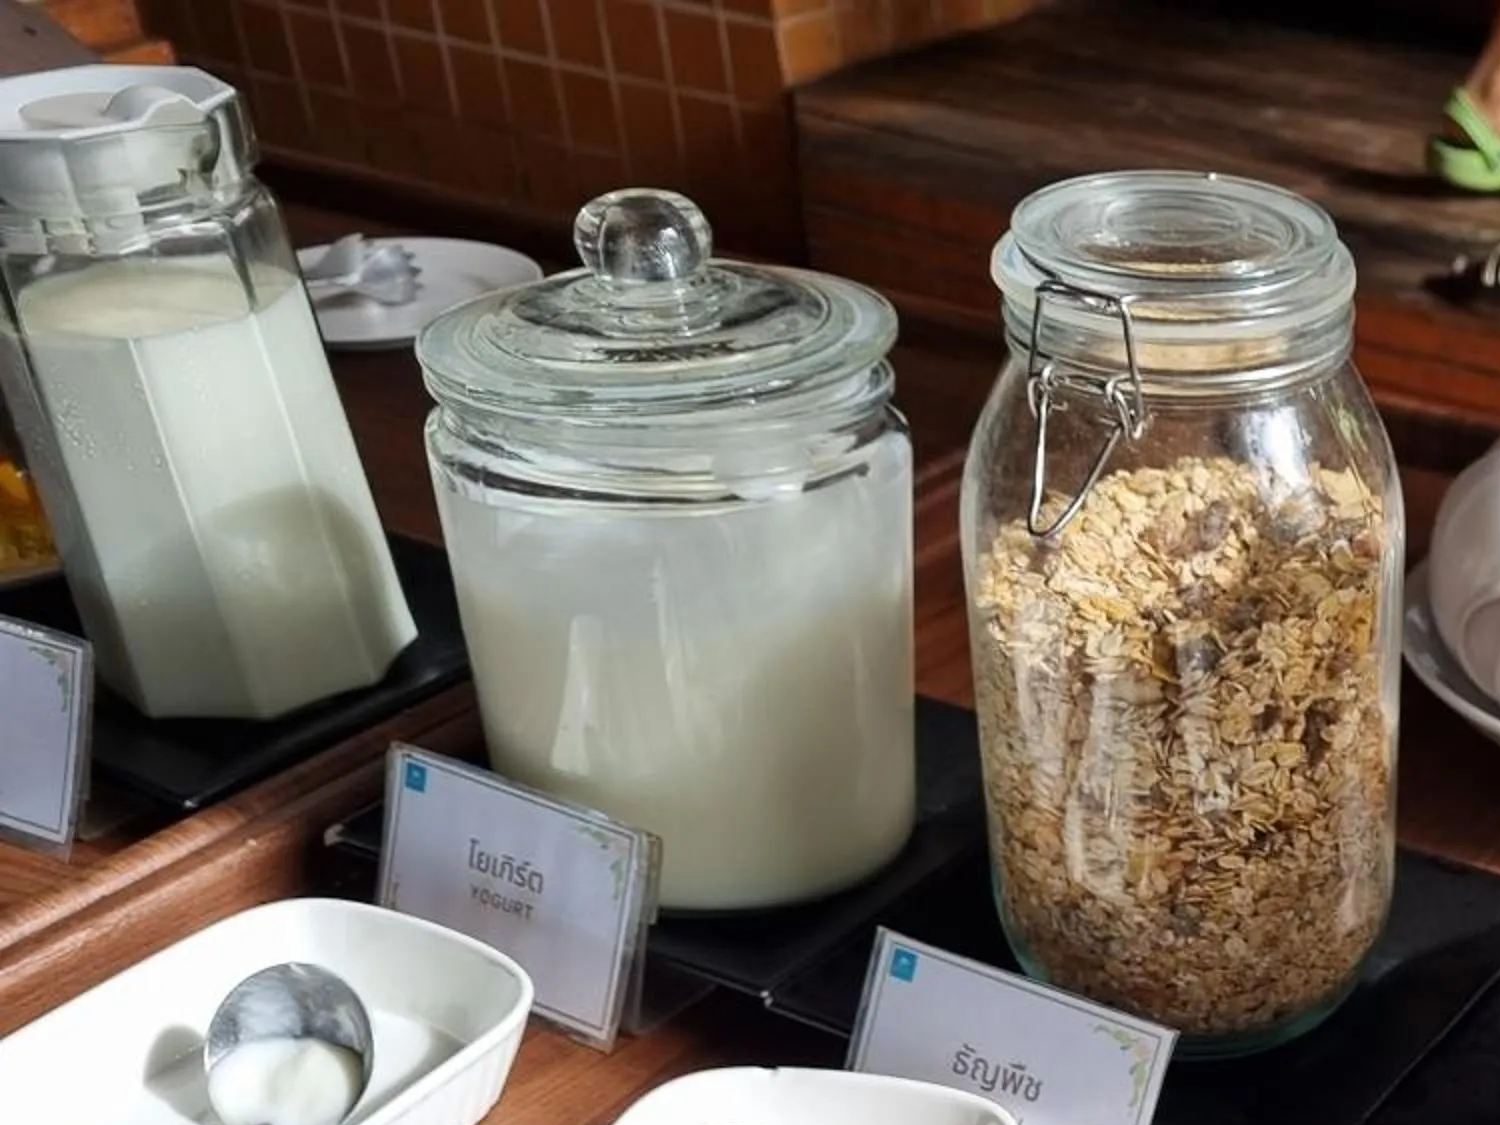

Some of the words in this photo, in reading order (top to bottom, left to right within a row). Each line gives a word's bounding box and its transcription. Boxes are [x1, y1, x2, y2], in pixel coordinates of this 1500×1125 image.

[467, 837, 544, 896] โยเกิร์ต
[470, 884, 535, 922] YOGURT
[952, 1043, 1043, 1103] ธัญพืช
